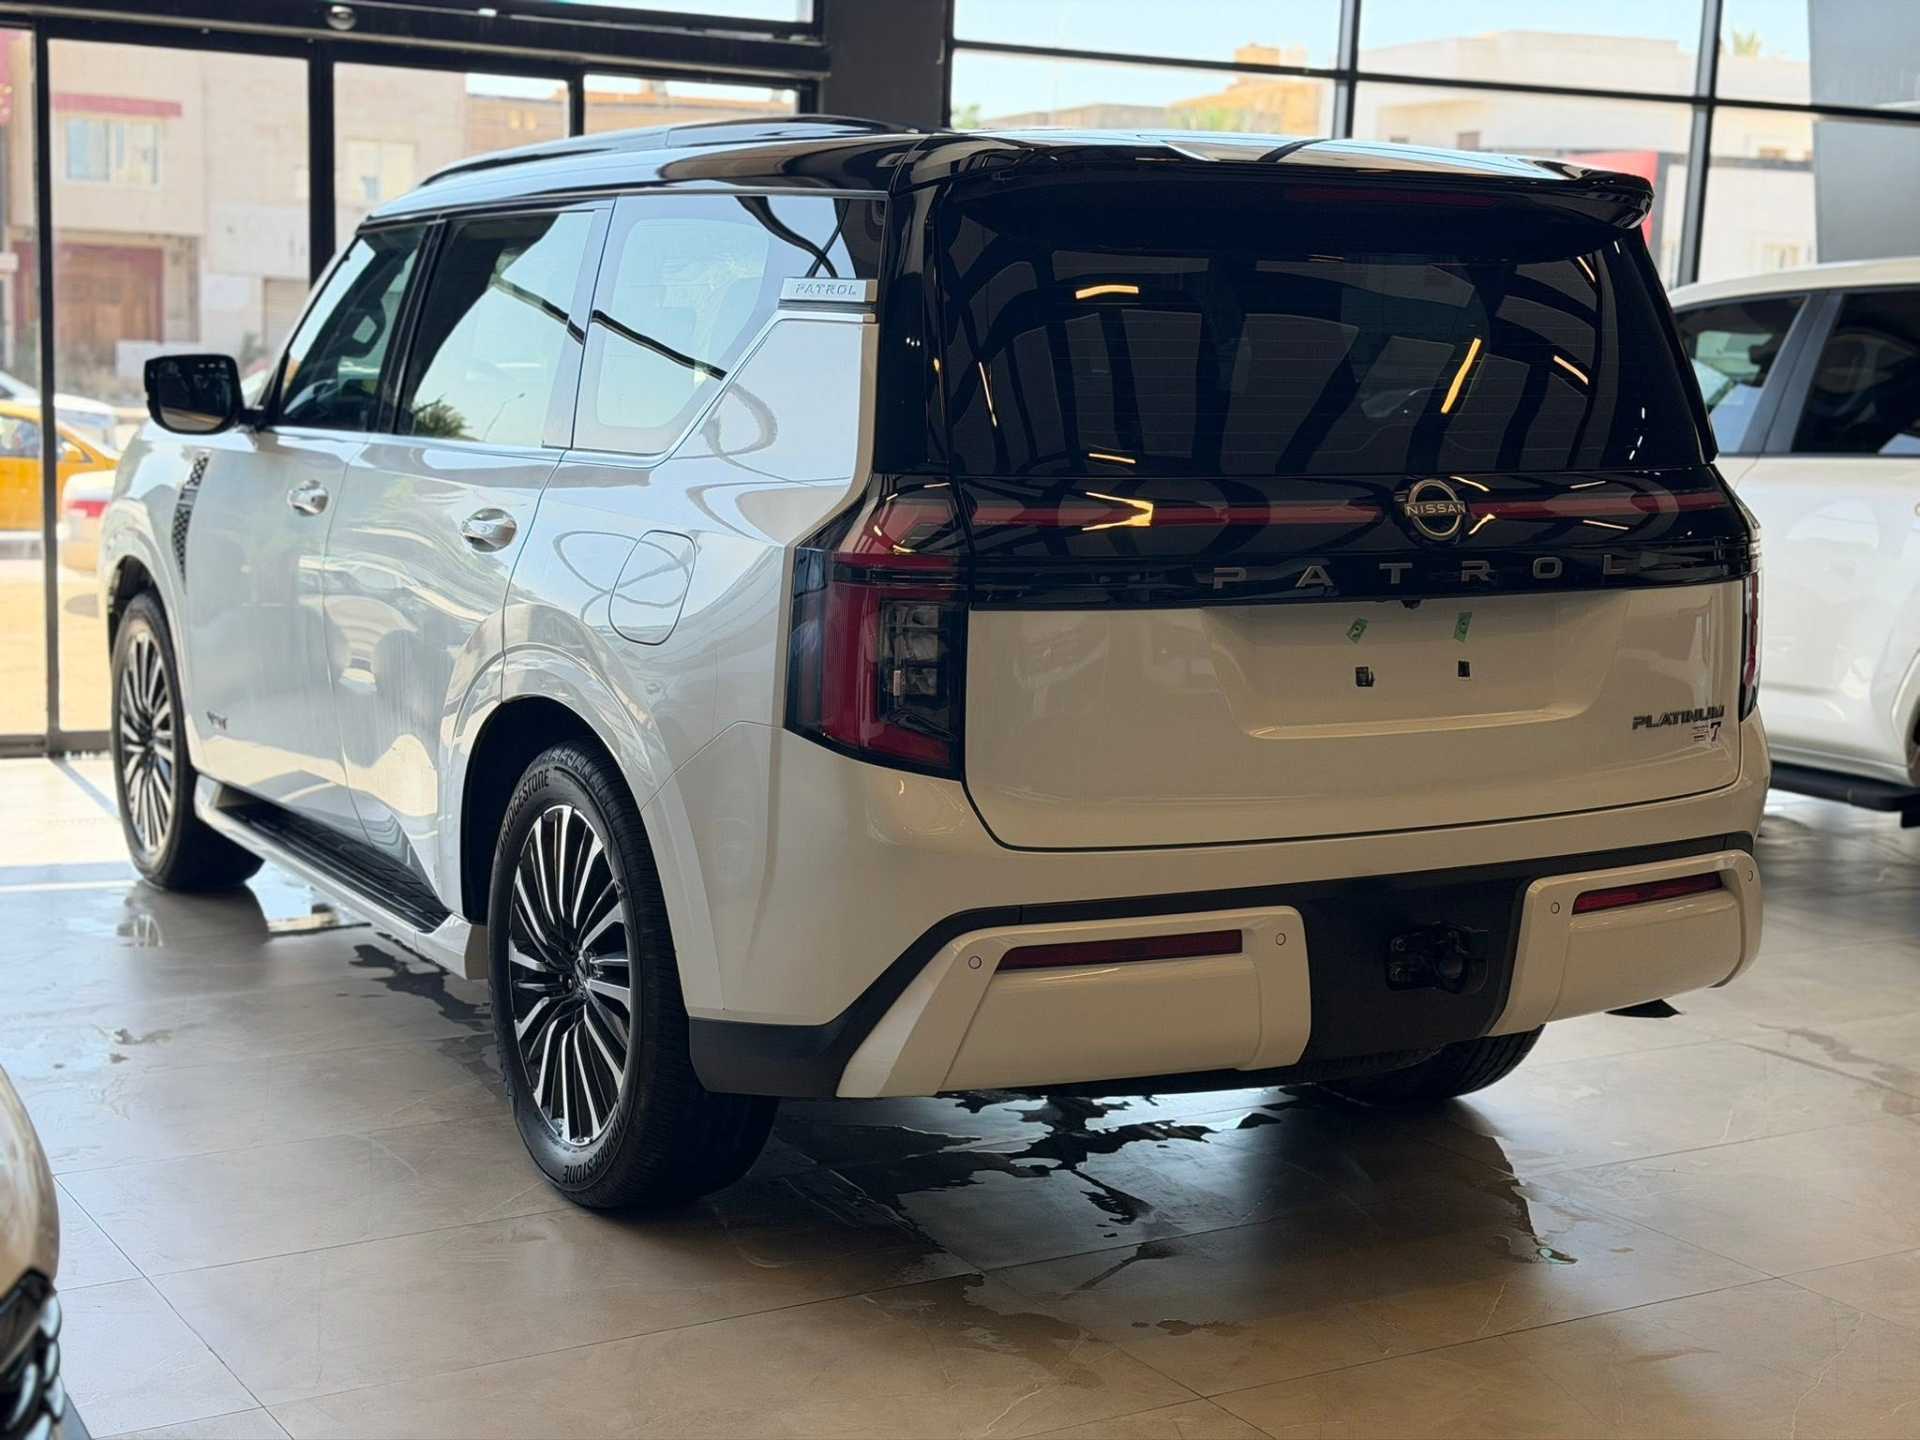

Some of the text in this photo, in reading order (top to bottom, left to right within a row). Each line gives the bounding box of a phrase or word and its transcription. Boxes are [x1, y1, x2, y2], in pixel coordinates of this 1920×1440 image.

[795, 283, 857, 296] PATROL
[1407, 503, 1467, 515] NISSAN
[1212, 554, 1627, 590] PATROL
[1632, 704, 1725, 730] PLATINUM
